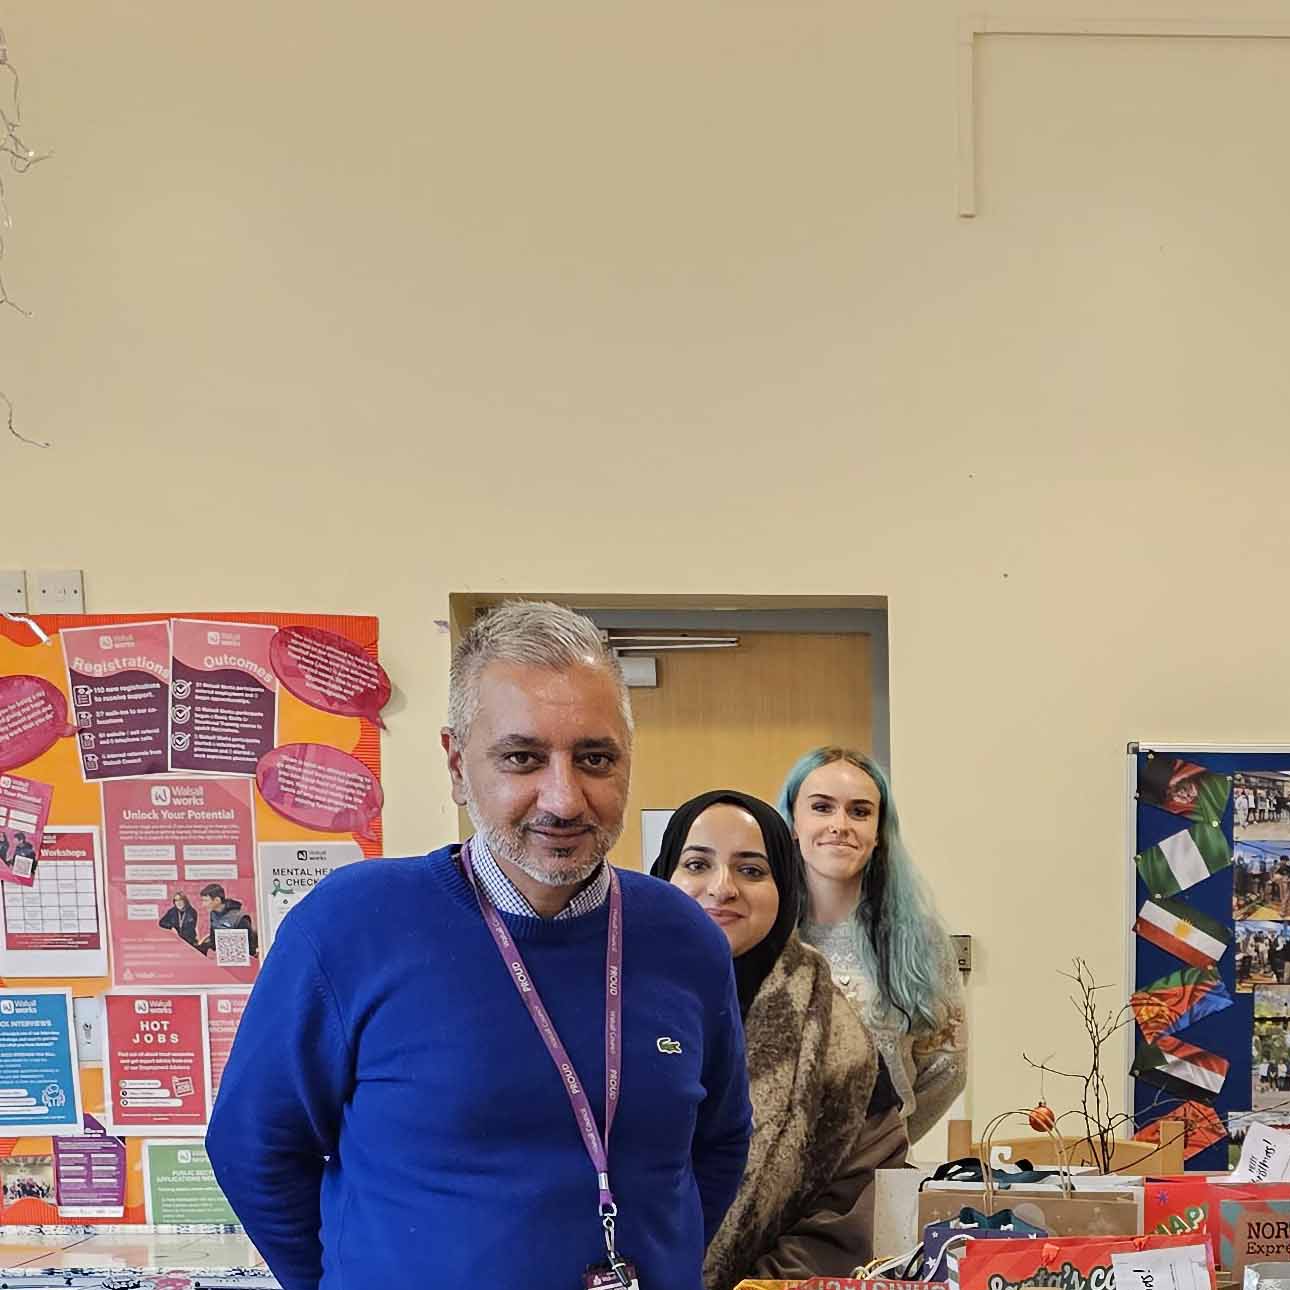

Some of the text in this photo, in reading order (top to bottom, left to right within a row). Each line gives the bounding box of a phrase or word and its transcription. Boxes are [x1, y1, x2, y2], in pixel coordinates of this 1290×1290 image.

[203, 655, 274, 683] Outcomes
[123, 809, 235, 820] Unlock Your Potential
[41, 848, 87, 859] Workshops
[272, 868, 313, 876] MENTAL
[511, 961, 532, 993] PROUD
[609, 965, 618, 996] PROUD
[140, 1020, 170, 1031] HOT
[132, 1033, 180, 1044] JOBS
[561, 1063, 580, 1095] PROUD
[609, 1069, 618, 1100] PROUD
